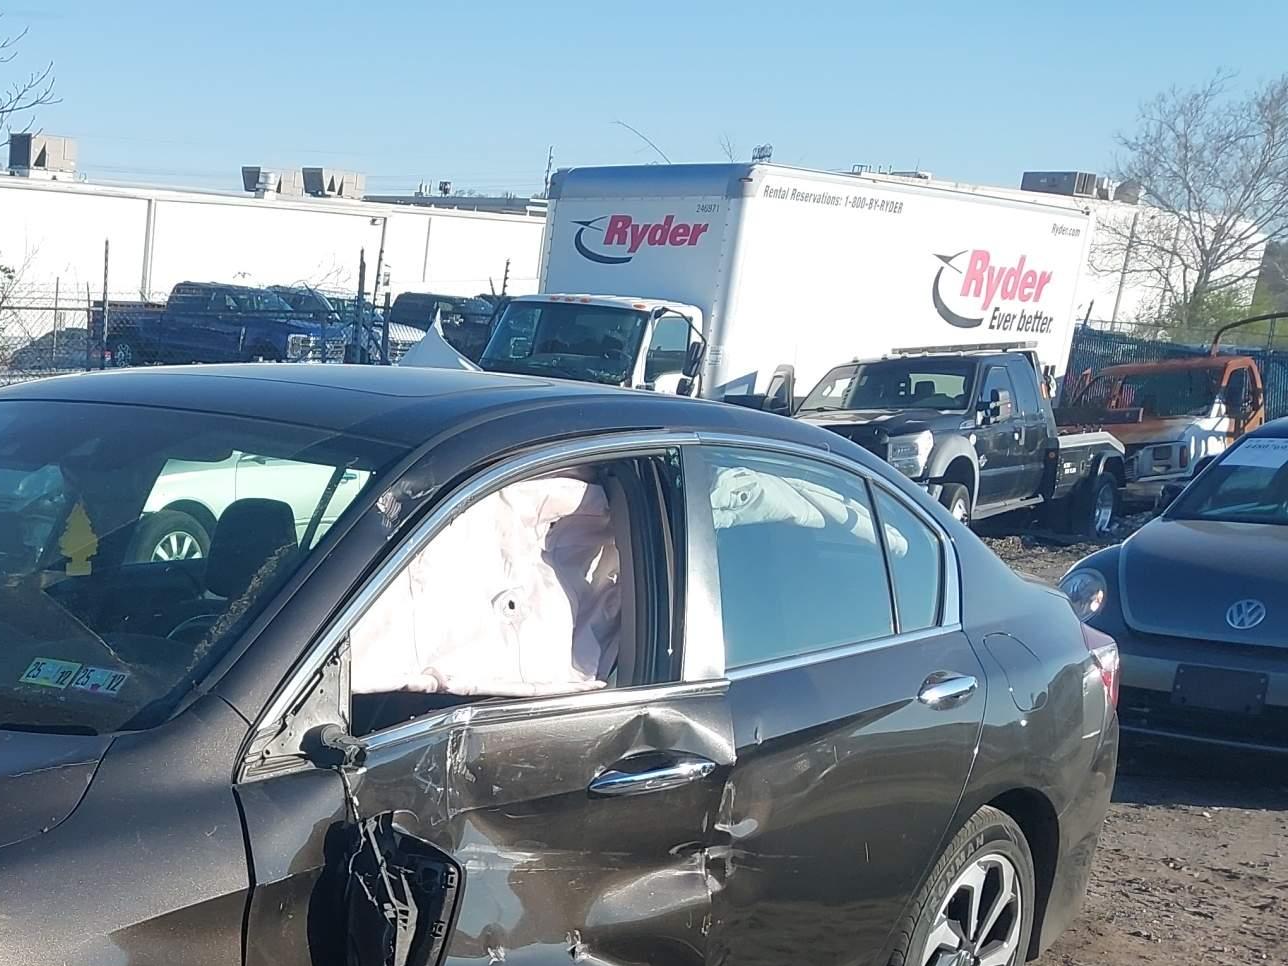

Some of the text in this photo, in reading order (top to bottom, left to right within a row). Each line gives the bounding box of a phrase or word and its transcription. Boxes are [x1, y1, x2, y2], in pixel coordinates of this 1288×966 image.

[763, 184, 904, 215] Rental Reservations: 1-800-BY-RYDER
[603, 214, 709, 253] Ryder
[1051, 223, 1081, 237] Ryder.com
[960, 249, 1053, 311] Ryder
[988, 306, 1054, 334] Ever better.
[25, 661, 73, 686] 25 12
[75, 667, 126, 692] 25 12
